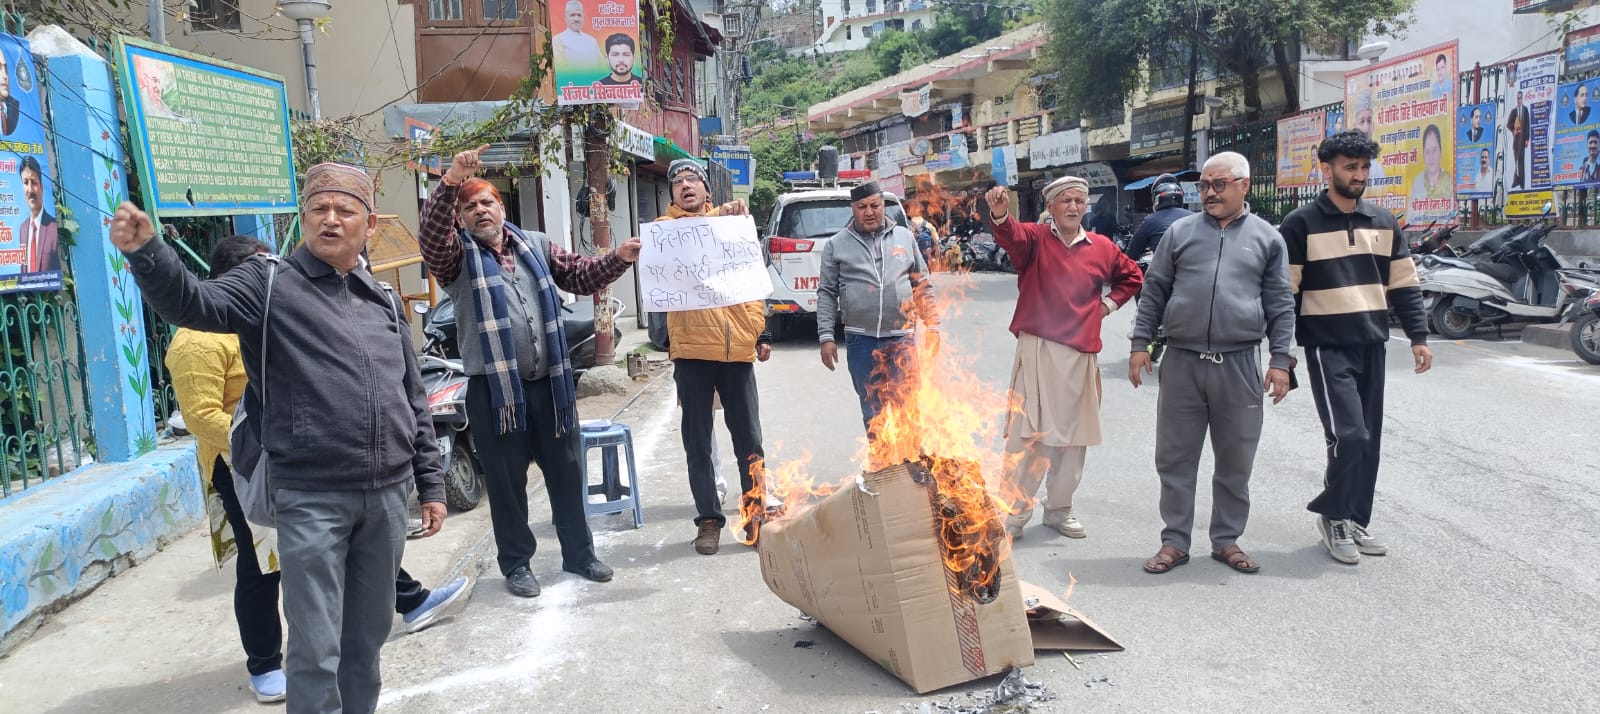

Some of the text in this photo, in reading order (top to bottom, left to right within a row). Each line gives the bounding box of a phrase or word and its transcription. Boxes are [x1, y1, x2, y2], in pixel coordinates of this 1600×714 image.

[561, 82, 591, 101] संजय
[1440, 93, 1448, 113] जी
[148, 131, 156, 143] OF
[156, 132, 173, 144] THESE
[151, 145, 160, 156] BY
[159, 146, 169, 157] ANY
[176, 147, 188, 158] THE
[713, 151, 748, 159] Collection
[1410, 147, 1418, 163] में
[173, 160, 191, 170] THREE
[156, 172, 177, 183] AMAZED
[176, 173, 189, 184] WHY
[794, 276, 820, 290] INT
